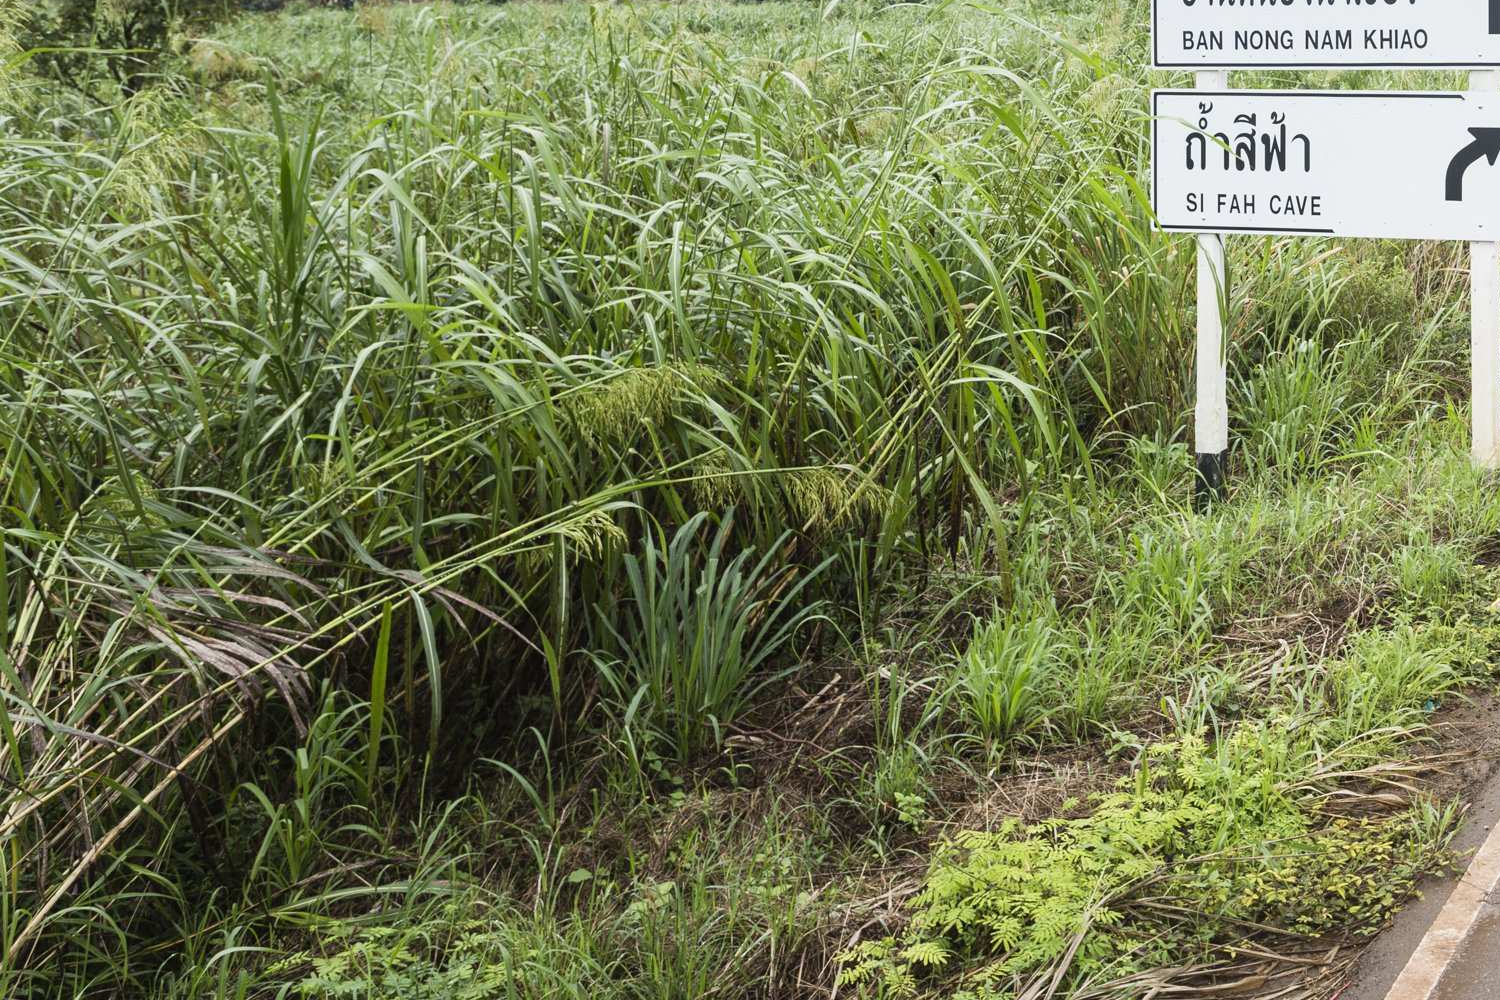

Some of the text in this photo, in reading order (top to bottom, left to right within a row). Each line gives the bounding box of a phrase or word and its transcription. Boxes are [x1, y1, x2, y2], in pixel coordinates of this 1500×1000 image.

[1182, 28, 1428, 51] BAN NONG NAM KHIAO
[1186, 192, 1321, 216] SI FAH CAVE
